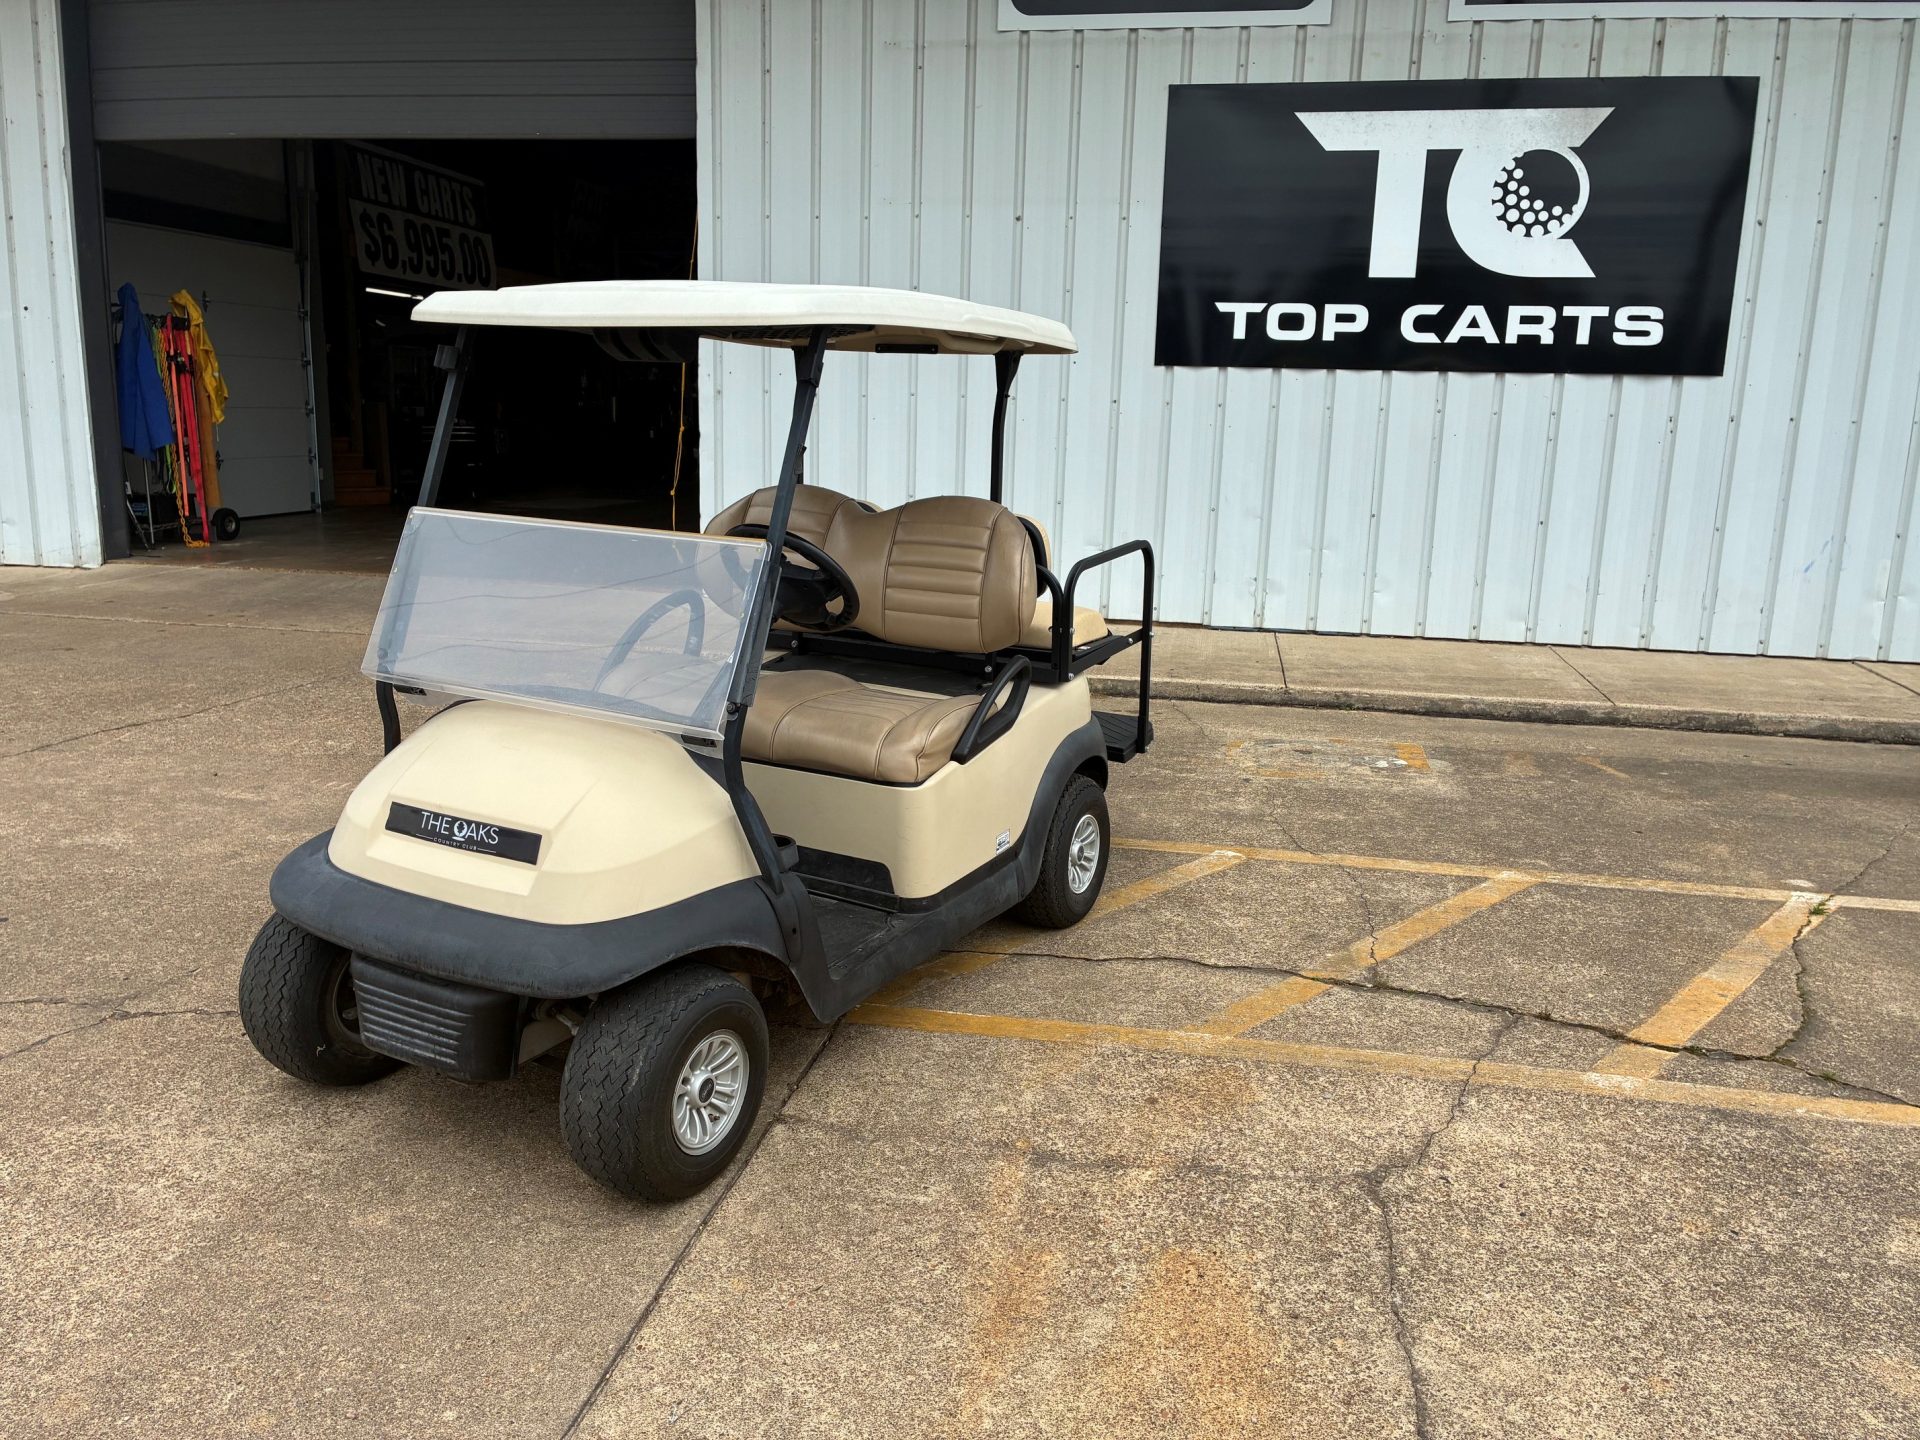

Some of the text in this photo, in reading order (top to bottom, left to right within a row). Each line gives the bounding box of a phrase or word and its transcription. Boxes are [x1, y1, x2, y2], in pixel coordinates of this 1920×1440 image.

[357, 151, 477, 227] NEW CARTS
[358, 208, 492, 288] $6,995.00
[1214, 302, 1665, 346] TOP CARTS
[421, 811, 499, 845] THE OAKS
[433, 837, 477, 851] COUNTRY CLUB
